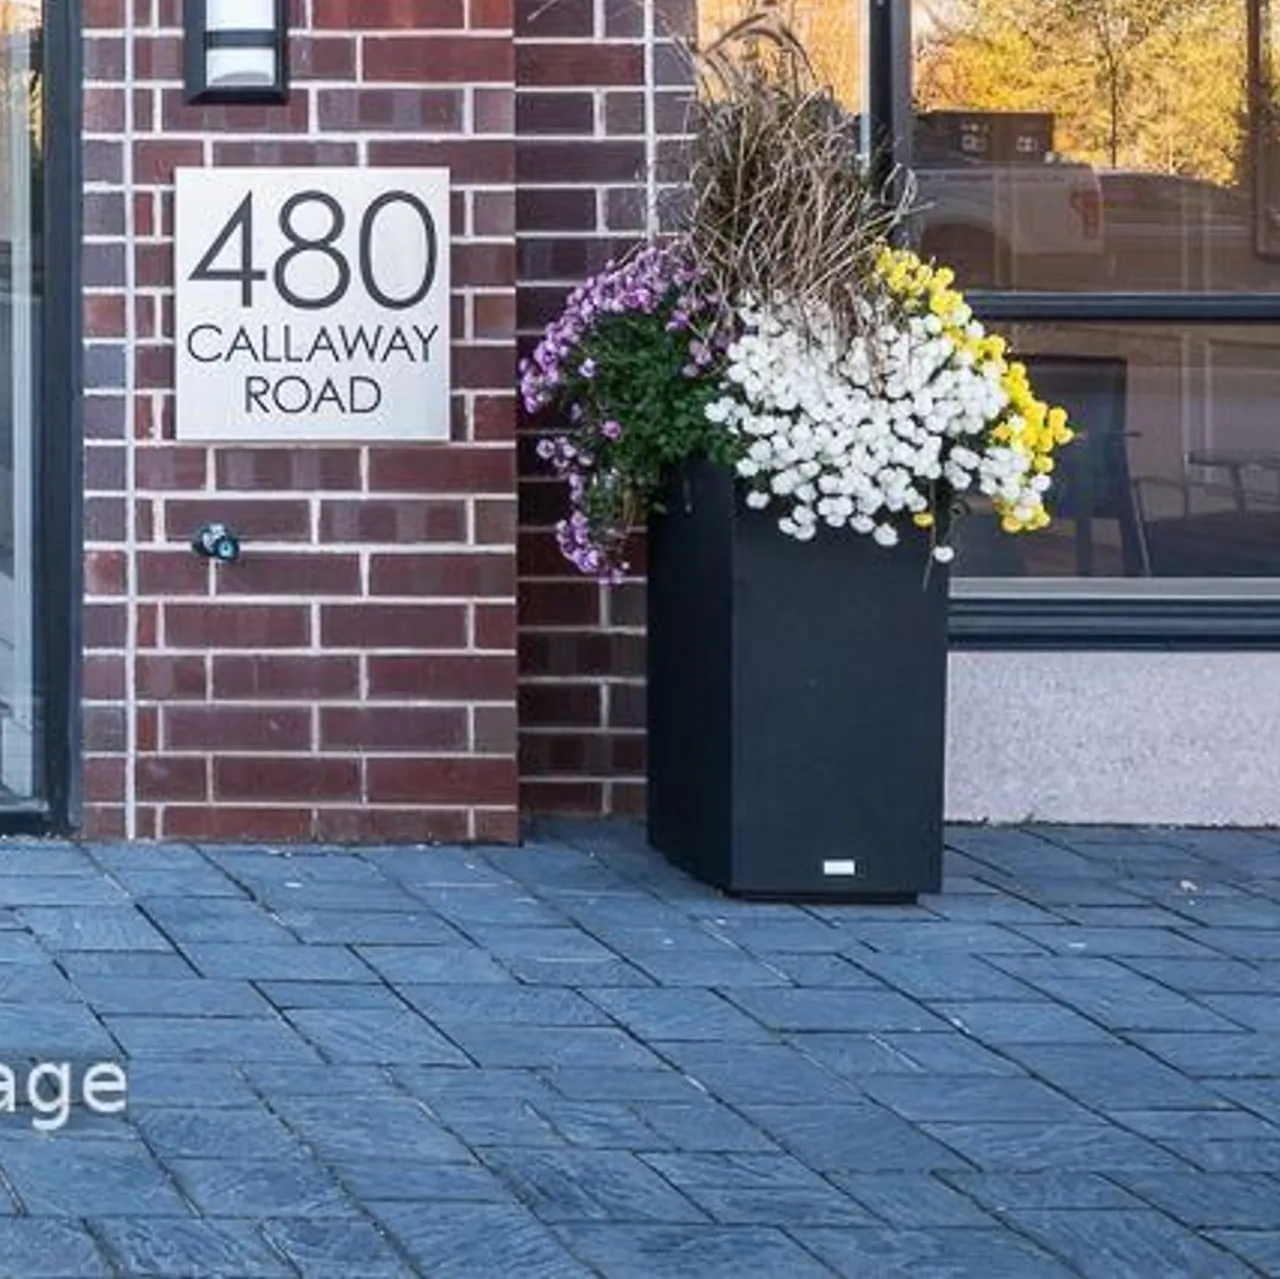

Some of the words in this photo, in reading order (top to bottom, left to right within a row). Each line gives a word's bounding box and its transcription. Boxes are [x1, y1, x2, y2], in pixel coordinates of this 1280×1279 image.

[188, 190, 438, 310] 480
[187, 324, 439, 363] CALLAWAY
[245, 375, 382, 414] ROAD
